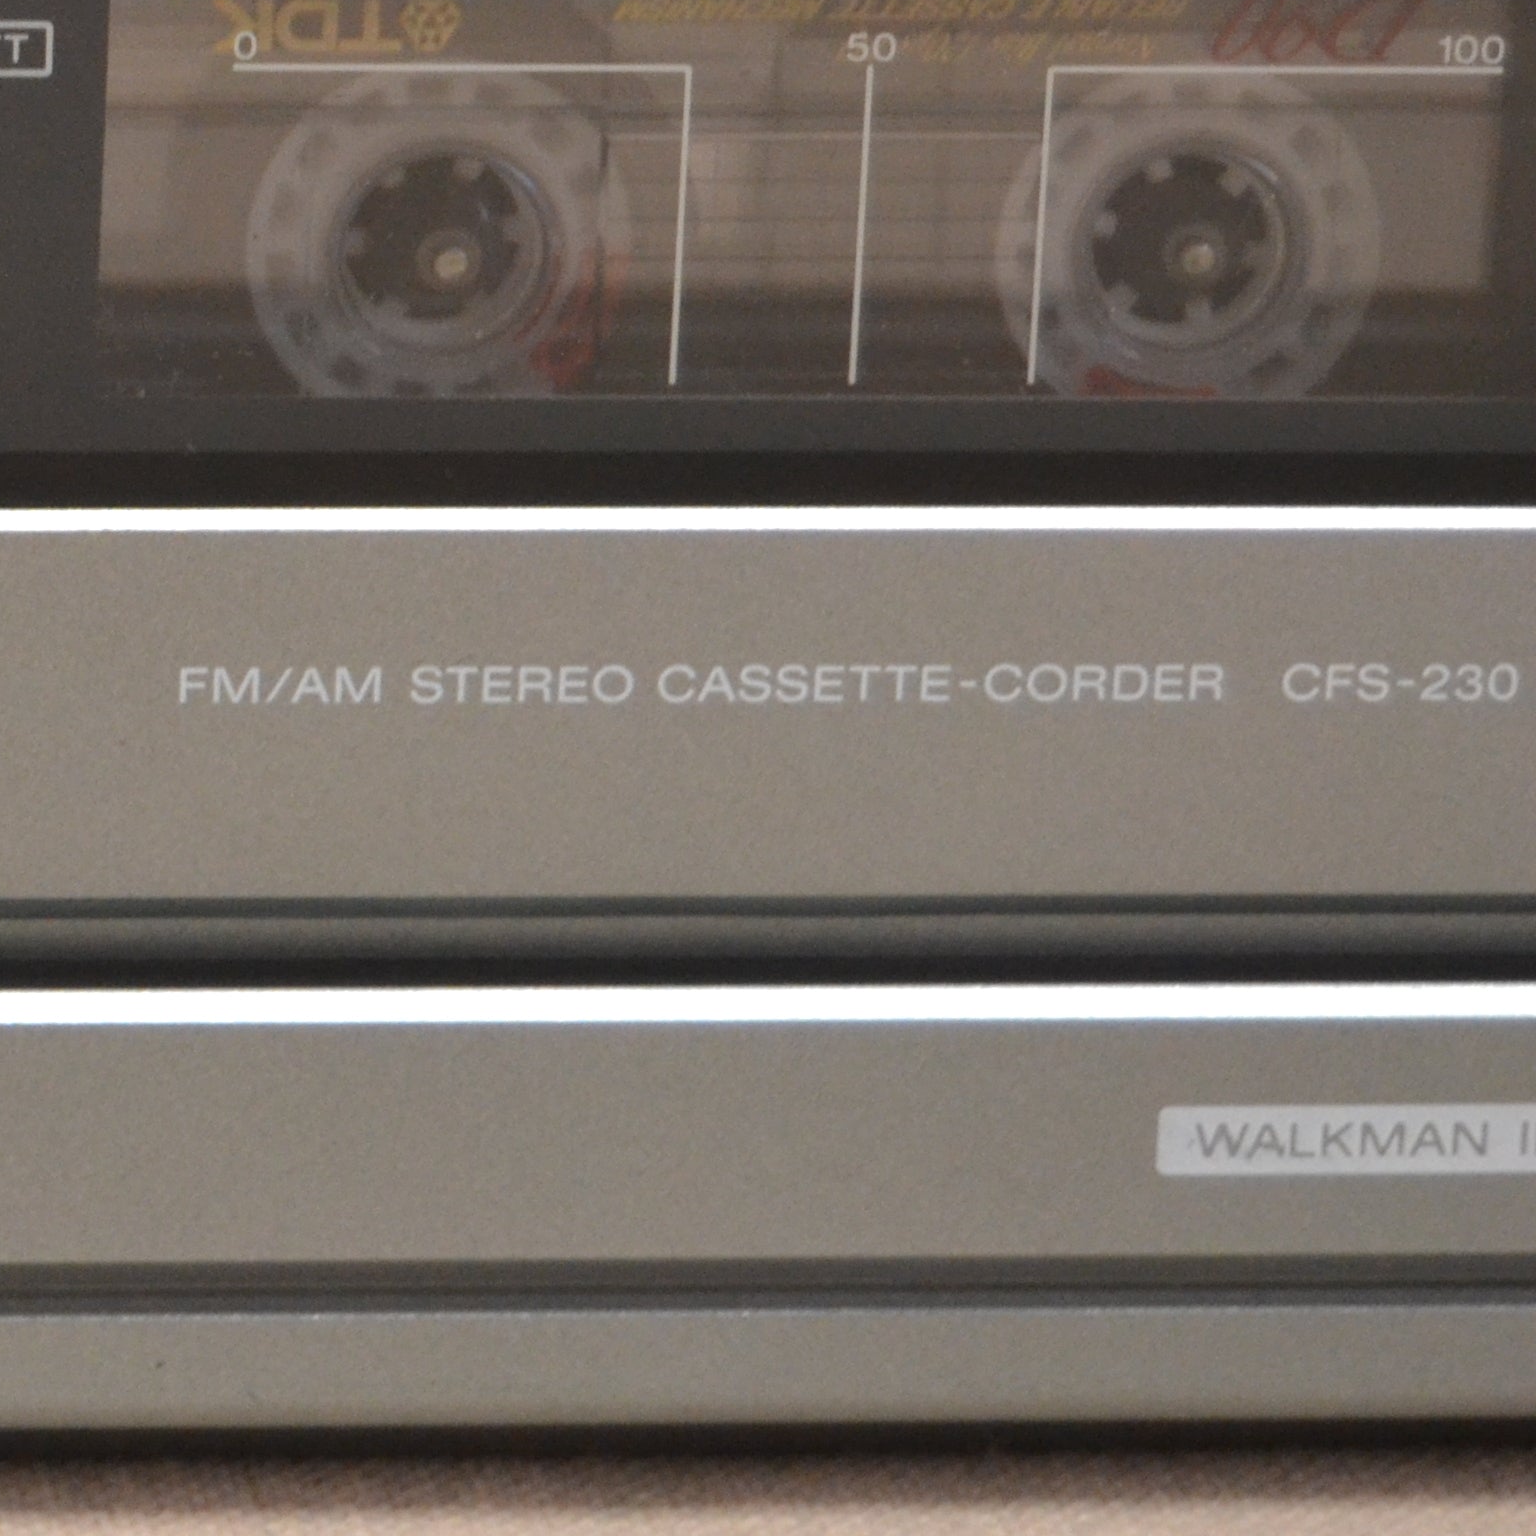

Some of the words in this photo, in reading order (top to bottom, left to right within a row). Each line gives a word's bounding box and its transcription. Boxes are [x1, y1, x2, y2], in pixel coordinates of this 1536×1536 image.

[233, 31, 258, 60] 0
[847, 33, 897, 62] 50
[1440, 35, 1505, 65] 100
[179, 666, 382, 704] FM/AM
[410, 664, 634, 705] STEREO
[657, 663, 1224, 704] CASSETTE-CORDER
[1282, 662, 1519, 703] CFS-230
[1195, 1121, 1489, 1159] WALKMAN
